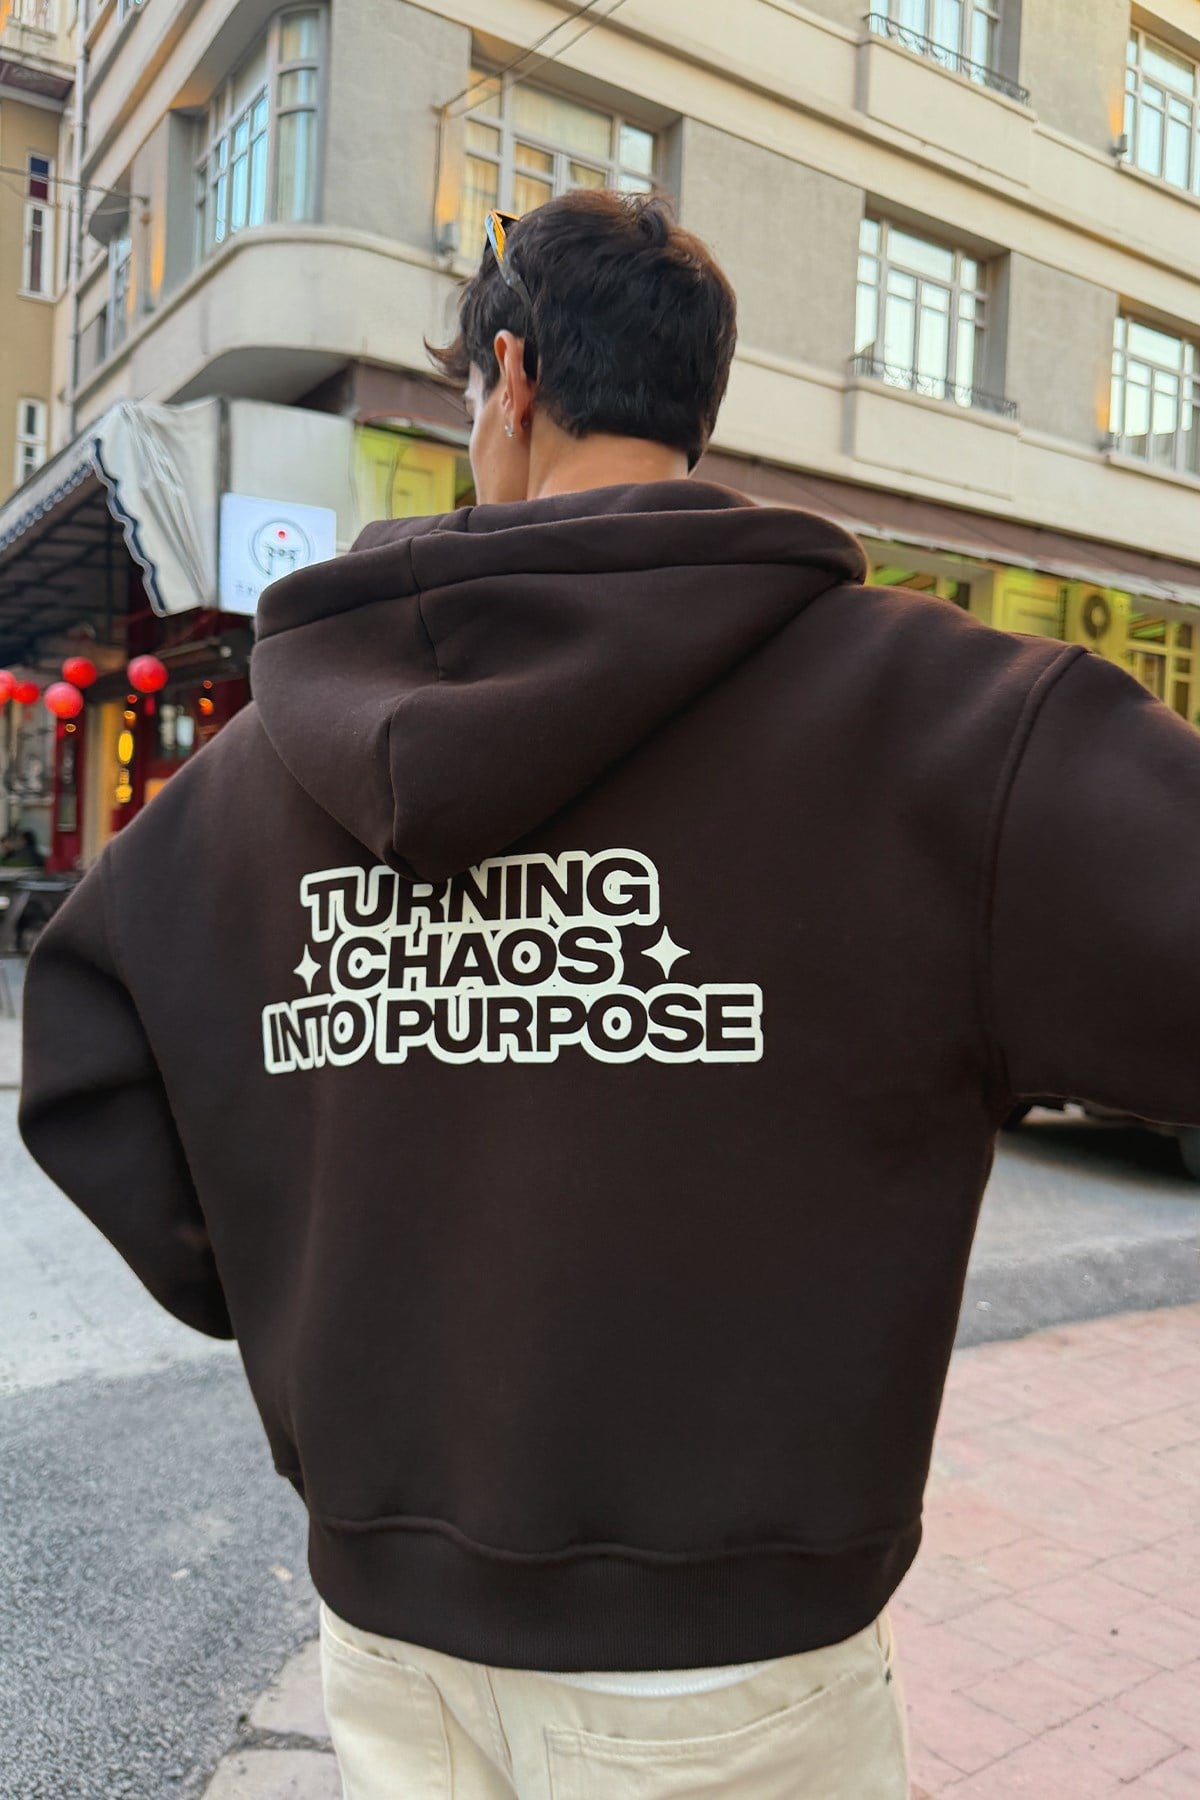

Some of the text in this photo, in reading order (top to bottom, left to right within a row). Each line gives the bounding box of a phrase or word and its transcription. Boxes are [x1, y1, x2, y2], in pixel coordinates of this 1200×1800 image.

[303, 852, 656, 935] TURNING
[333, 924, 619, 993] CHAOS
[265, 988, 760, 1070] INTO PURPOSE
